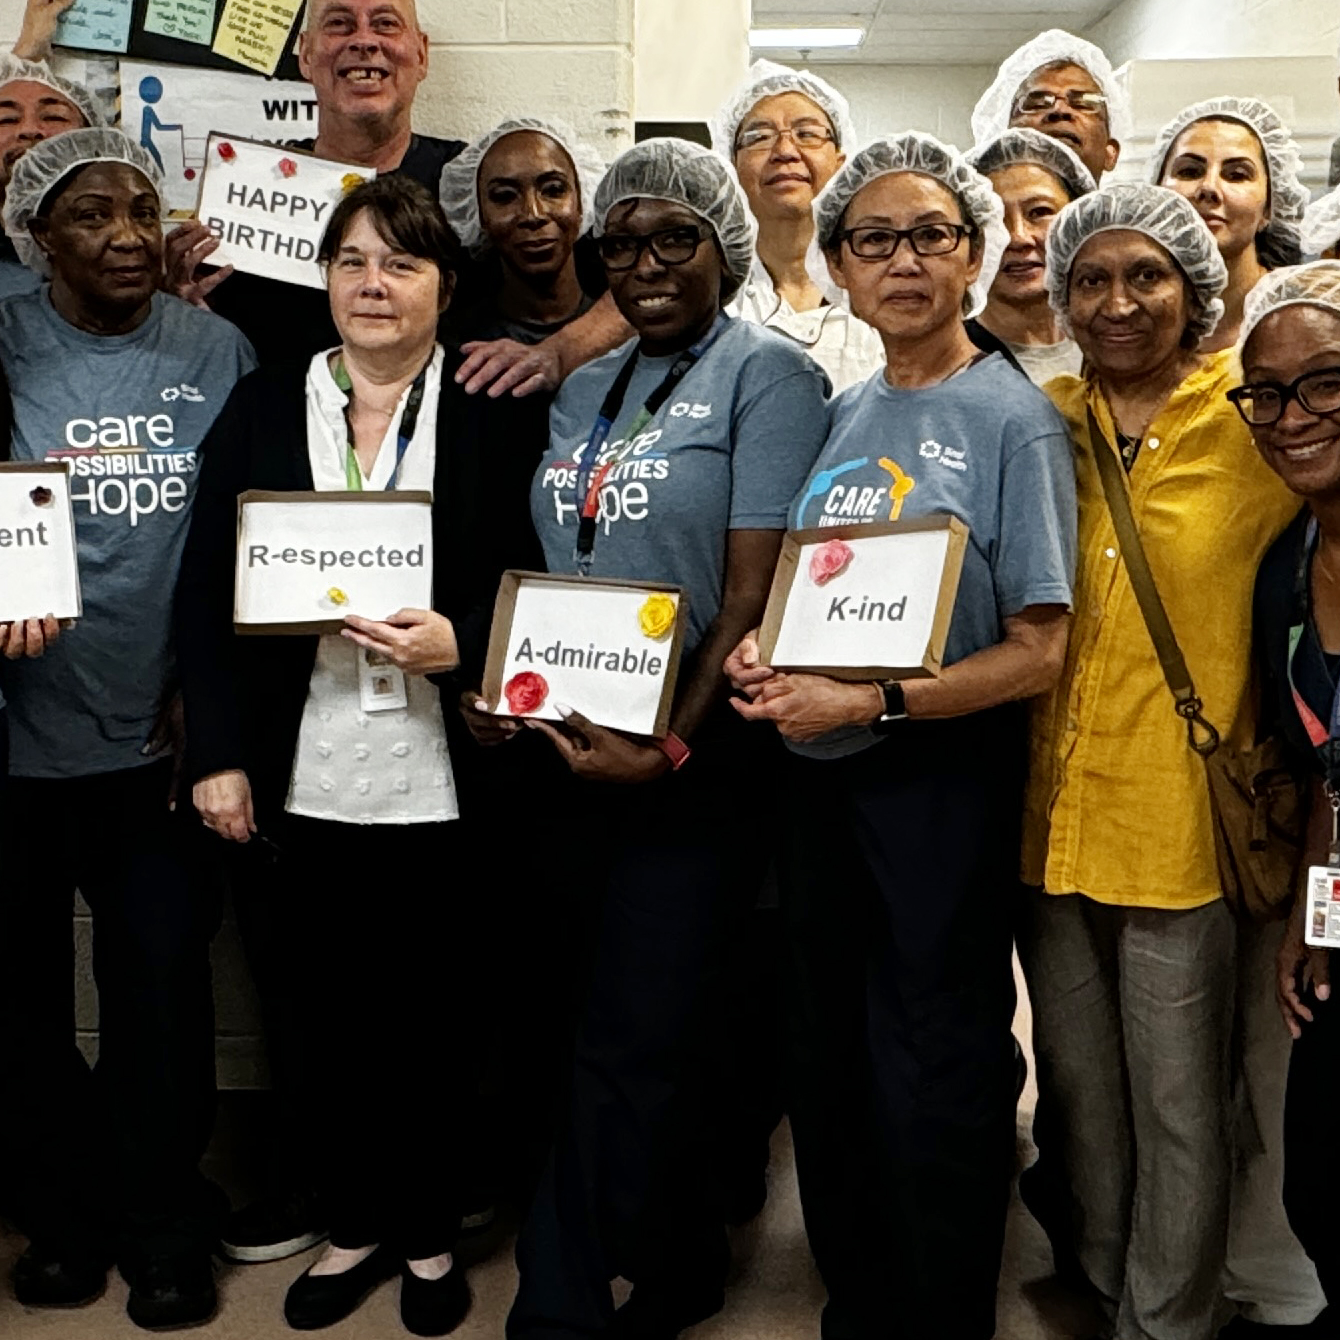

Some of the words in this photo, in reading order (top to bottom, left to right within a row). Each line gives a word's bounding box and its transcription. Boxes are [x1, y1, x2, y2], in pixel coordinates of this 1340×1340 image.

[226, 182, 328, 222] HAPPY
[65, 414, 174, 448] care
[71, 476, 187, 527] Hope
[824, 484, 889, 517] CARE
[248, 544, 425, 572] R-espected
[827, 596, 908, 622] K-ind
[514, 636, 662, 676] A-dmirable
